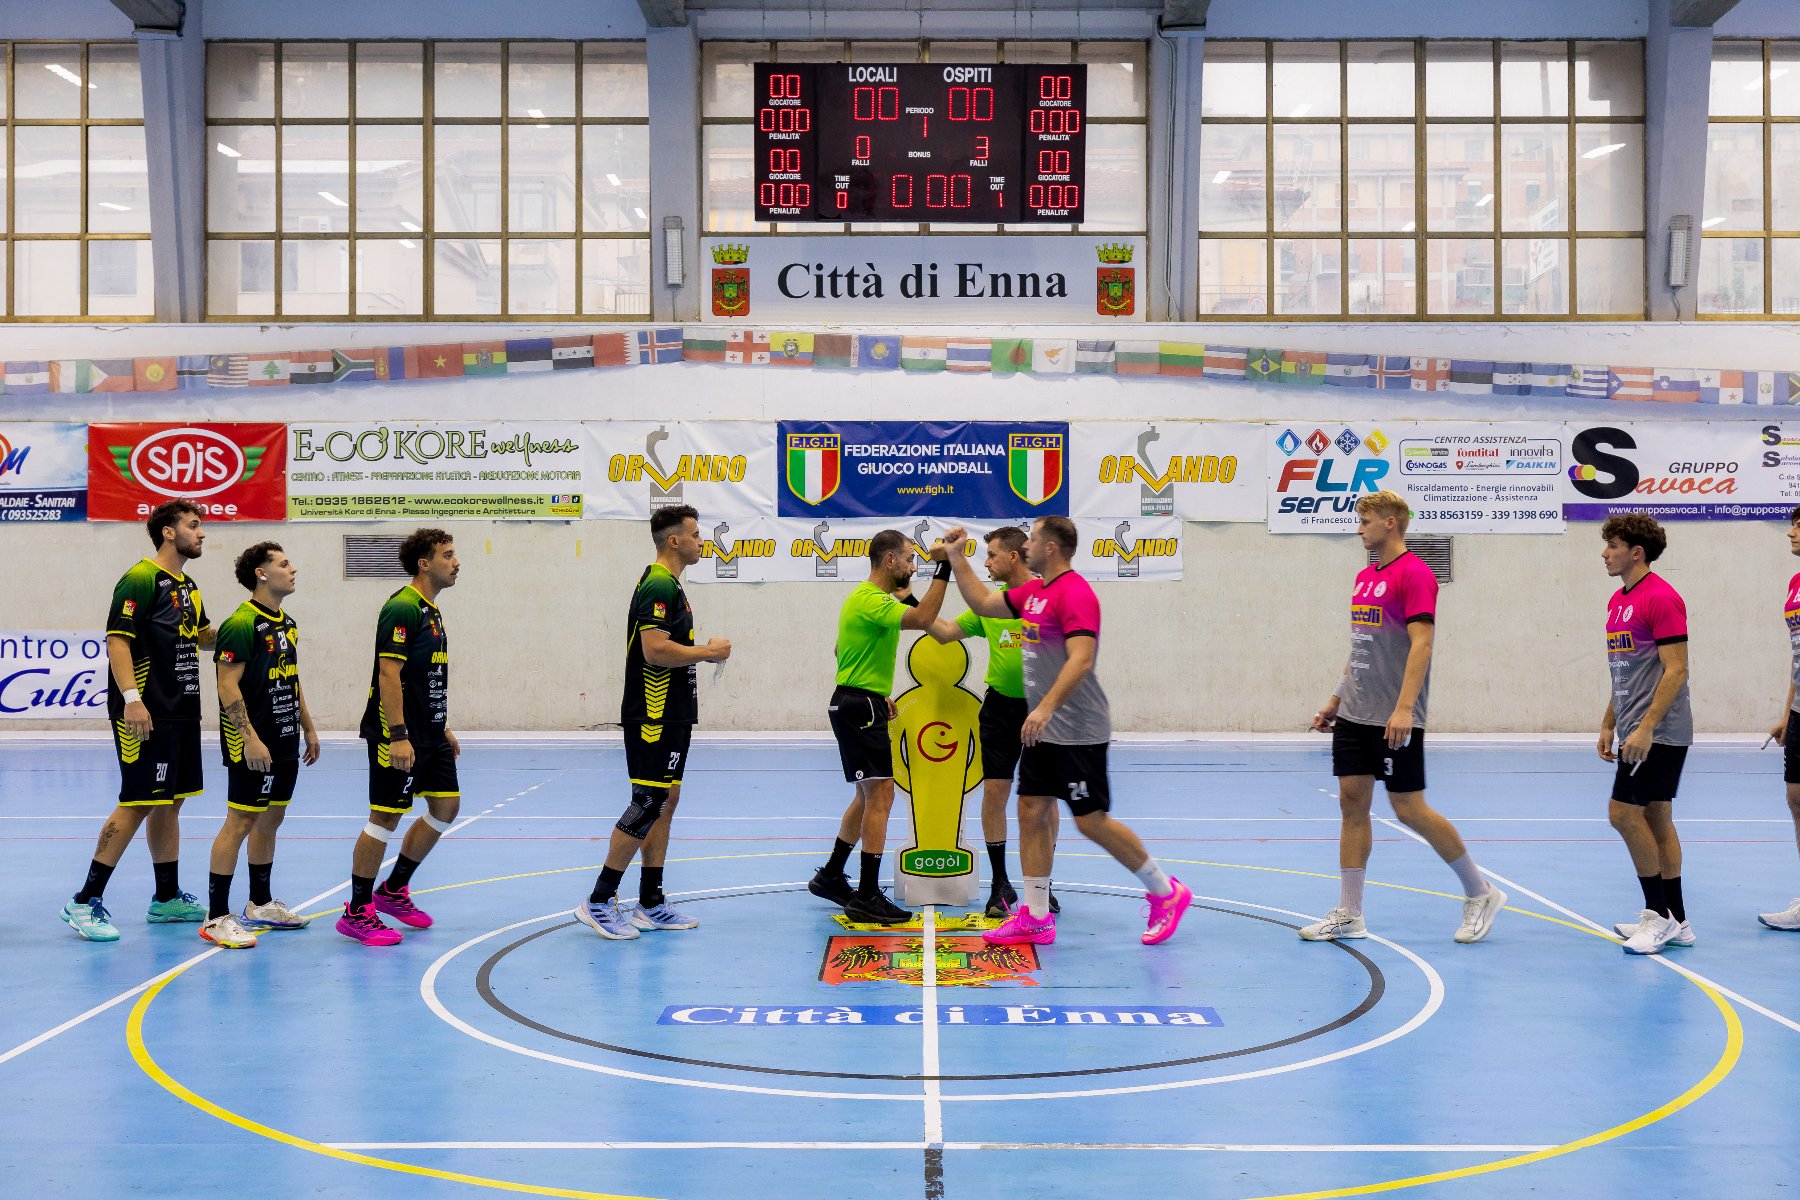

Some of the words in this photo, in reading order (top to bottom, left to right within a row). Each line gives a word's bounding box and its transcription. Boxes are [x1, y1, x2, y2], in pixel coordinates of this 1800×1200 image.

[848, 67, 897, 83] LOCALI
[943, 67, 992, 83] OSPITI
[854, 87, 899, 121] 00
[949, 87, 994, 121] 00
[975, 136, 989, 159] 3
[777, 262, 884, 299] Città
[899, 262, 940, 299] di
[953, 263, 1068, 299] Enna
[791, 437, 838, 448] F.I.G.H.
[1013, 437, 1060, 448] F.I.G.H.
[845, 444, 941, 457] FEDERAZIONE
[943, 444, 1005, 456] ITALIANA
[1457, 448, 1499, 457] fondital
[858, 462, 914, 475] GIUOCO
[917, 462, 992, 474] HANDBALL
[1516, 461, 1556, 469] DAIKIN
[1668, 462, 1739, 473] GRUPPO
[1277, 459, 1390, 492] FLR
[897, 485, 954, 496] www.figh.it
[1407, 484, 1469, 492] Riscaldamento
[1476, 484, 1507, 493] Energie
[292, 497, 313, 506] Tel.:
[315, 497, 347, 505] 0935
[351, 496, 406, 505] 1862612
[414, 496, 544, 505] www.ecokorewellness.it
[8, 510, 61, 520] 093525283
[431, 508, 475, 516] Ingegneria
[1419, 511, 1437, 519] 333
[1440, 511, 1483, 519] 8563159
[1491, 511, 1512, 519] 339
[1514, 511, 1537, 519] 1398
[1538, 511, 1558, 519] 690
[668, 752, 680, 770] 27
[1383, 758, 1393, 776] 3
[402, 777, 413, 794] 2
[914, 855, 960, 870] gogòl
[670, 1005, 863, 1024] Città
